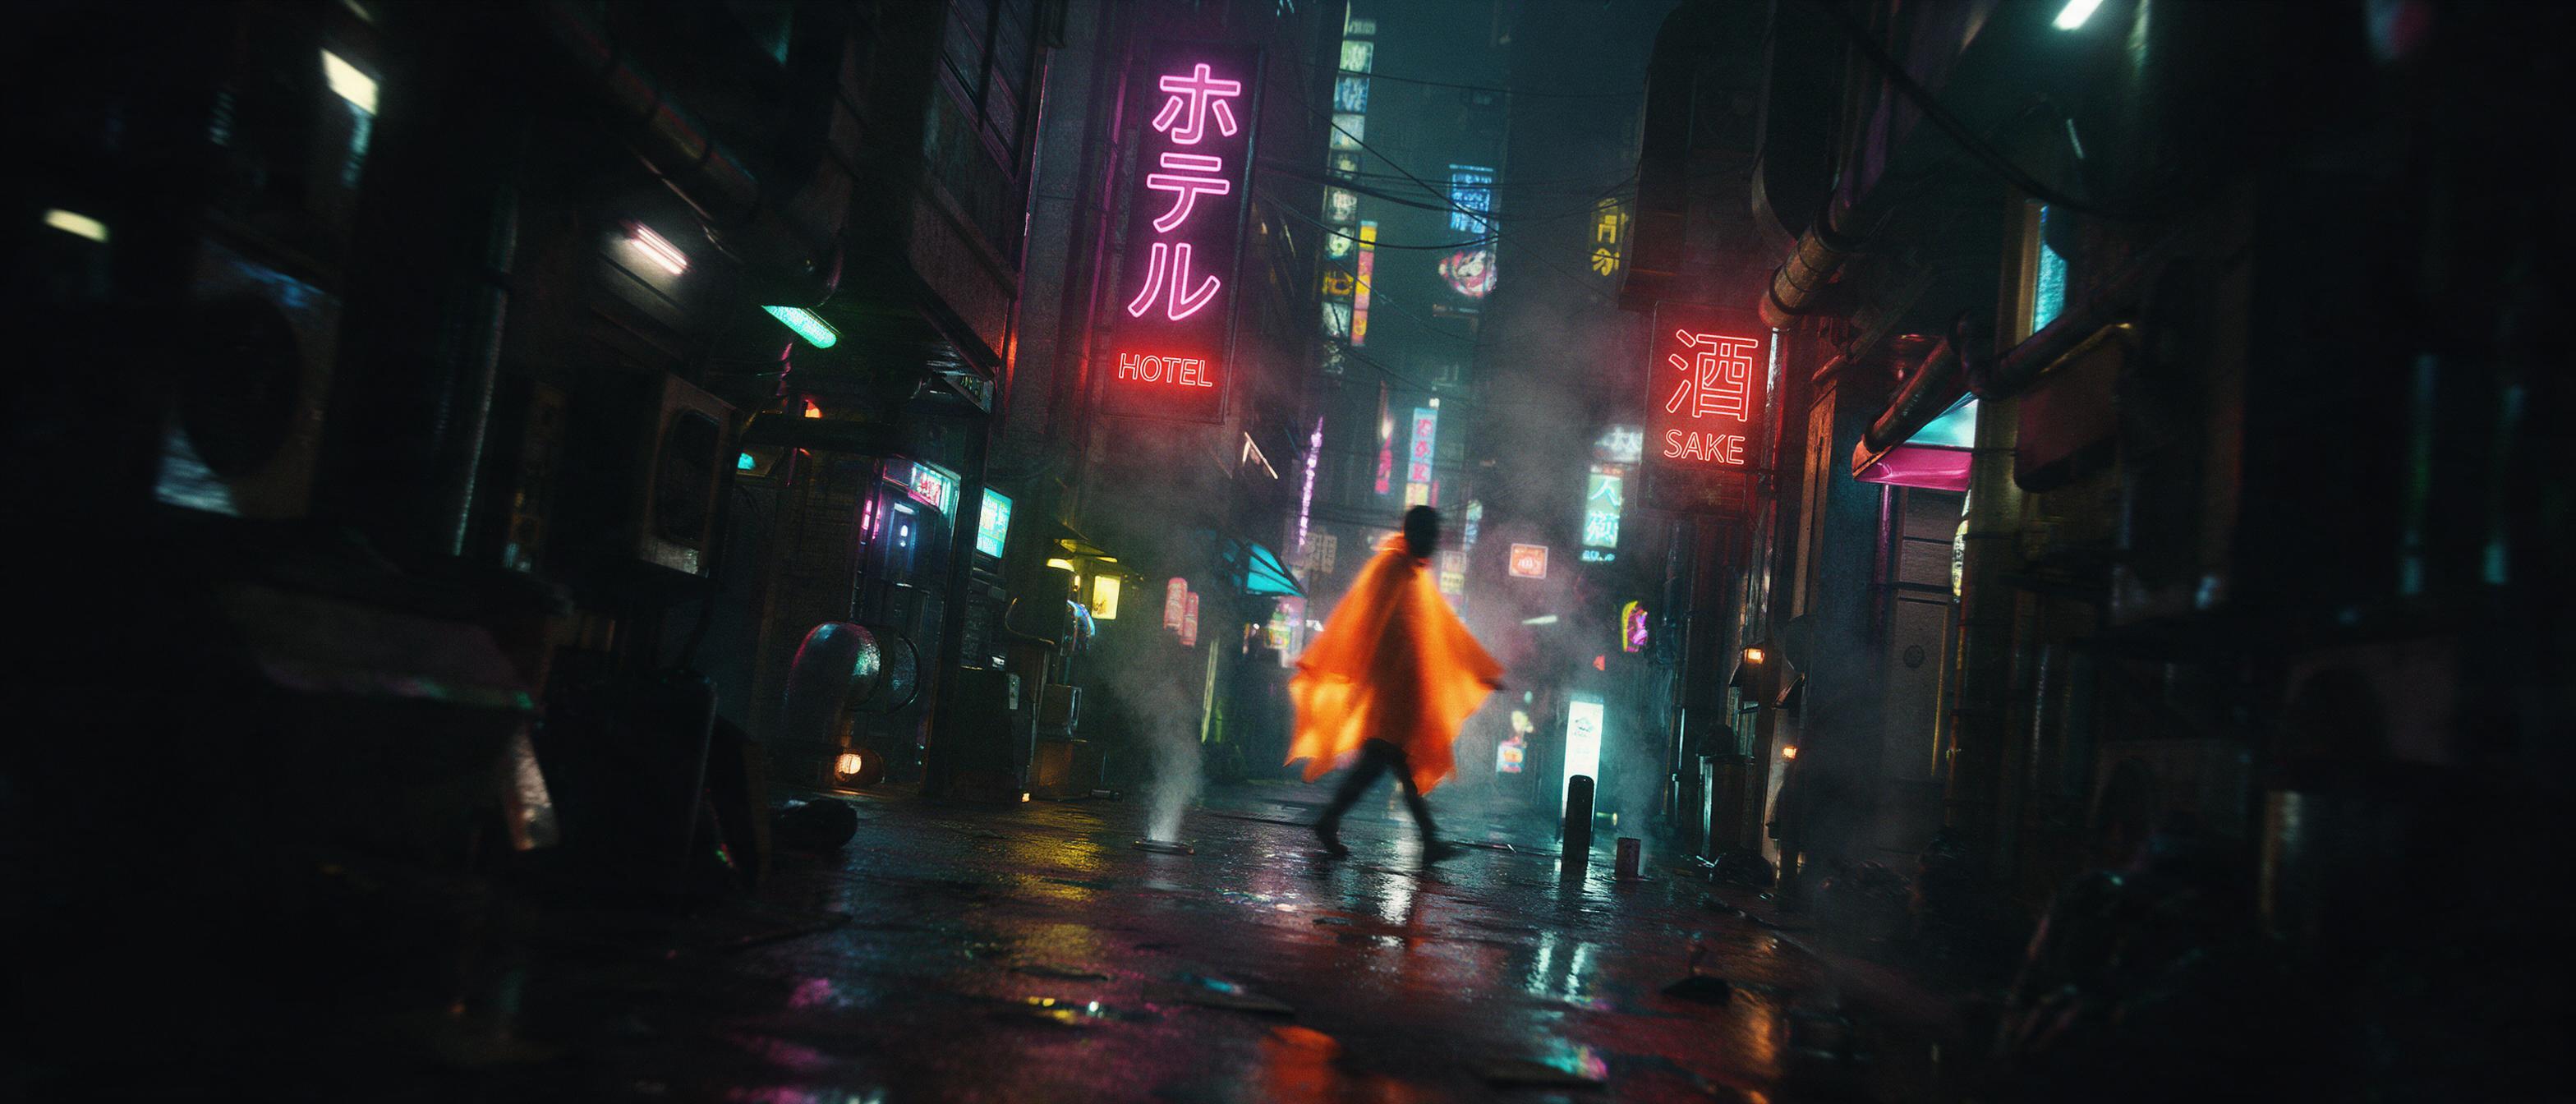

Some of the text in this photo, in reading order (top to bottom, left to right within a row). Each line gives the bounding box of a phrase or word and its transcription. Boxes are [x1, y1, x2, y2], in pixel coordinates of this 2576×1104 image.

[1128, 63, 1241, 321] ホテル
[1118, 352, 1212, 387] HOTEL
[1665, 329, 1758, 422] 酒
[1663, 429, 1746, 465] SAKE
